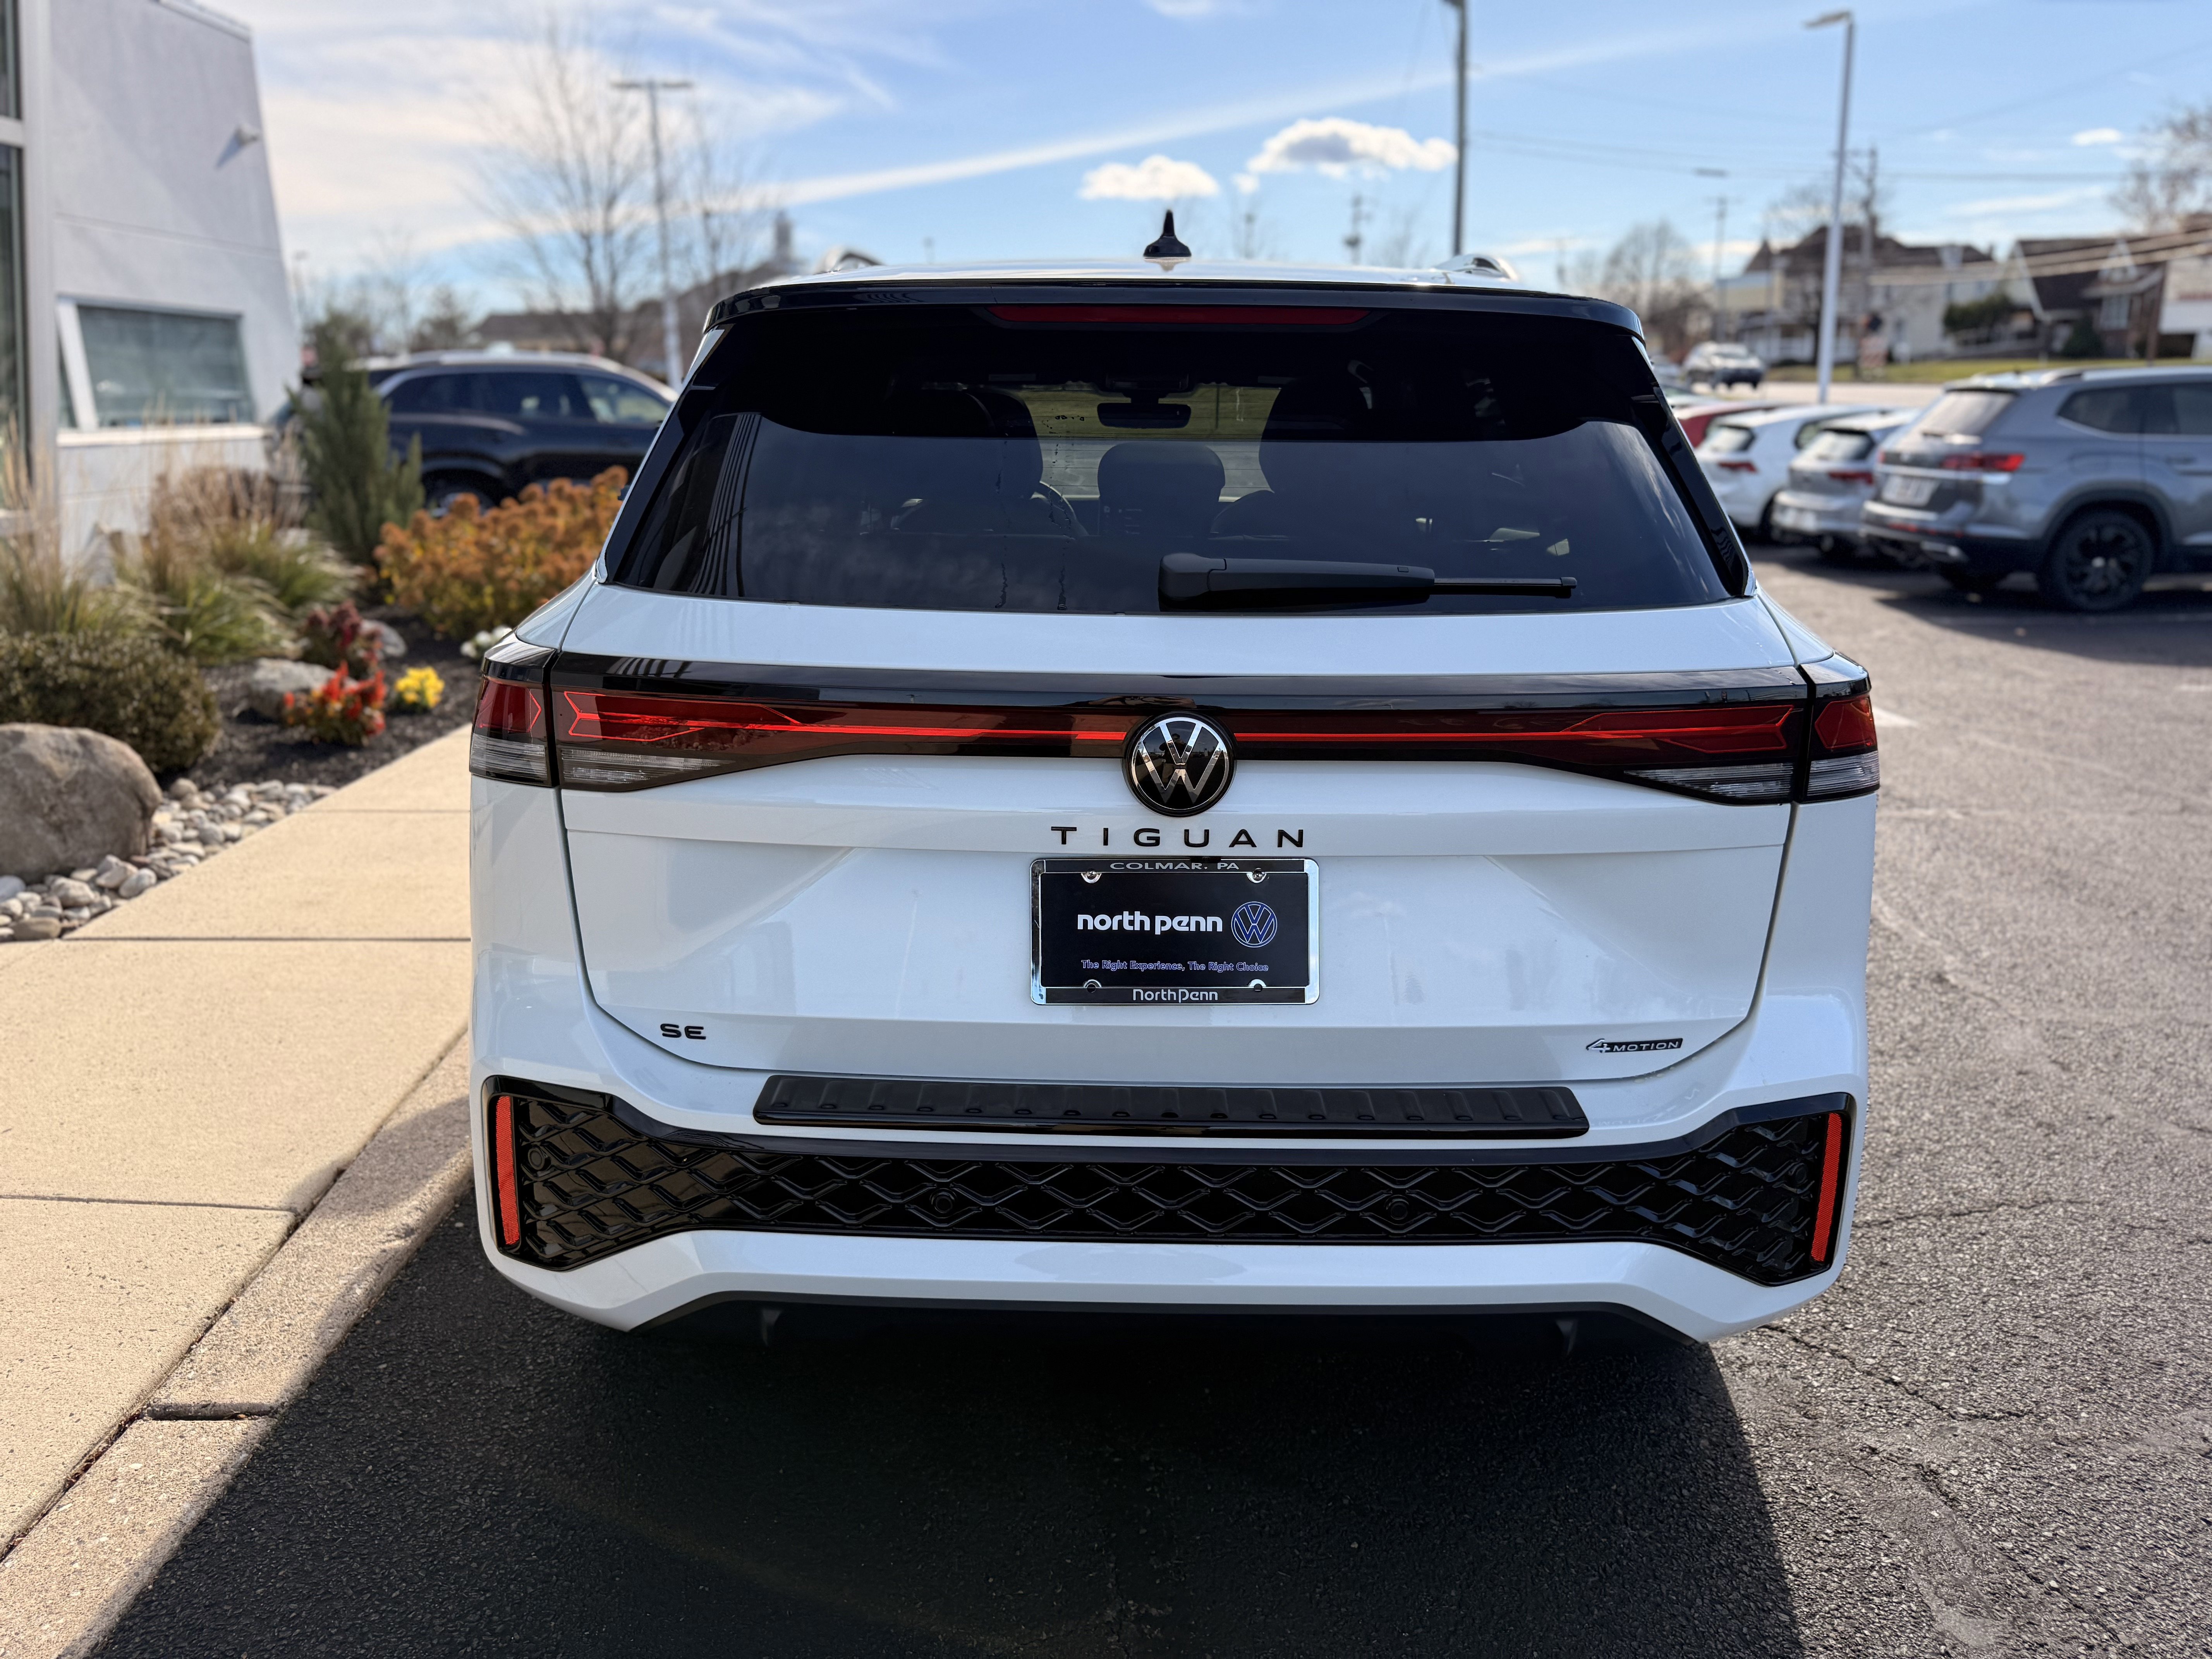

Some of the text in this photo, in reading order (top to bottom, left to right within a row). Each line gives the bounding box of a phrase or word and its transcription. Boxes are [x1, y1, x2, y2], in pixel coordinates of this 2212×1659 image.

[1051, 826, 1304, 848] TIGUAN
[1077, 911, 1223, 935] north penn
[1081, 960, 1269, 973] The Right Experience, The Right Choice
[660, 1024, 706, 1040] SE
